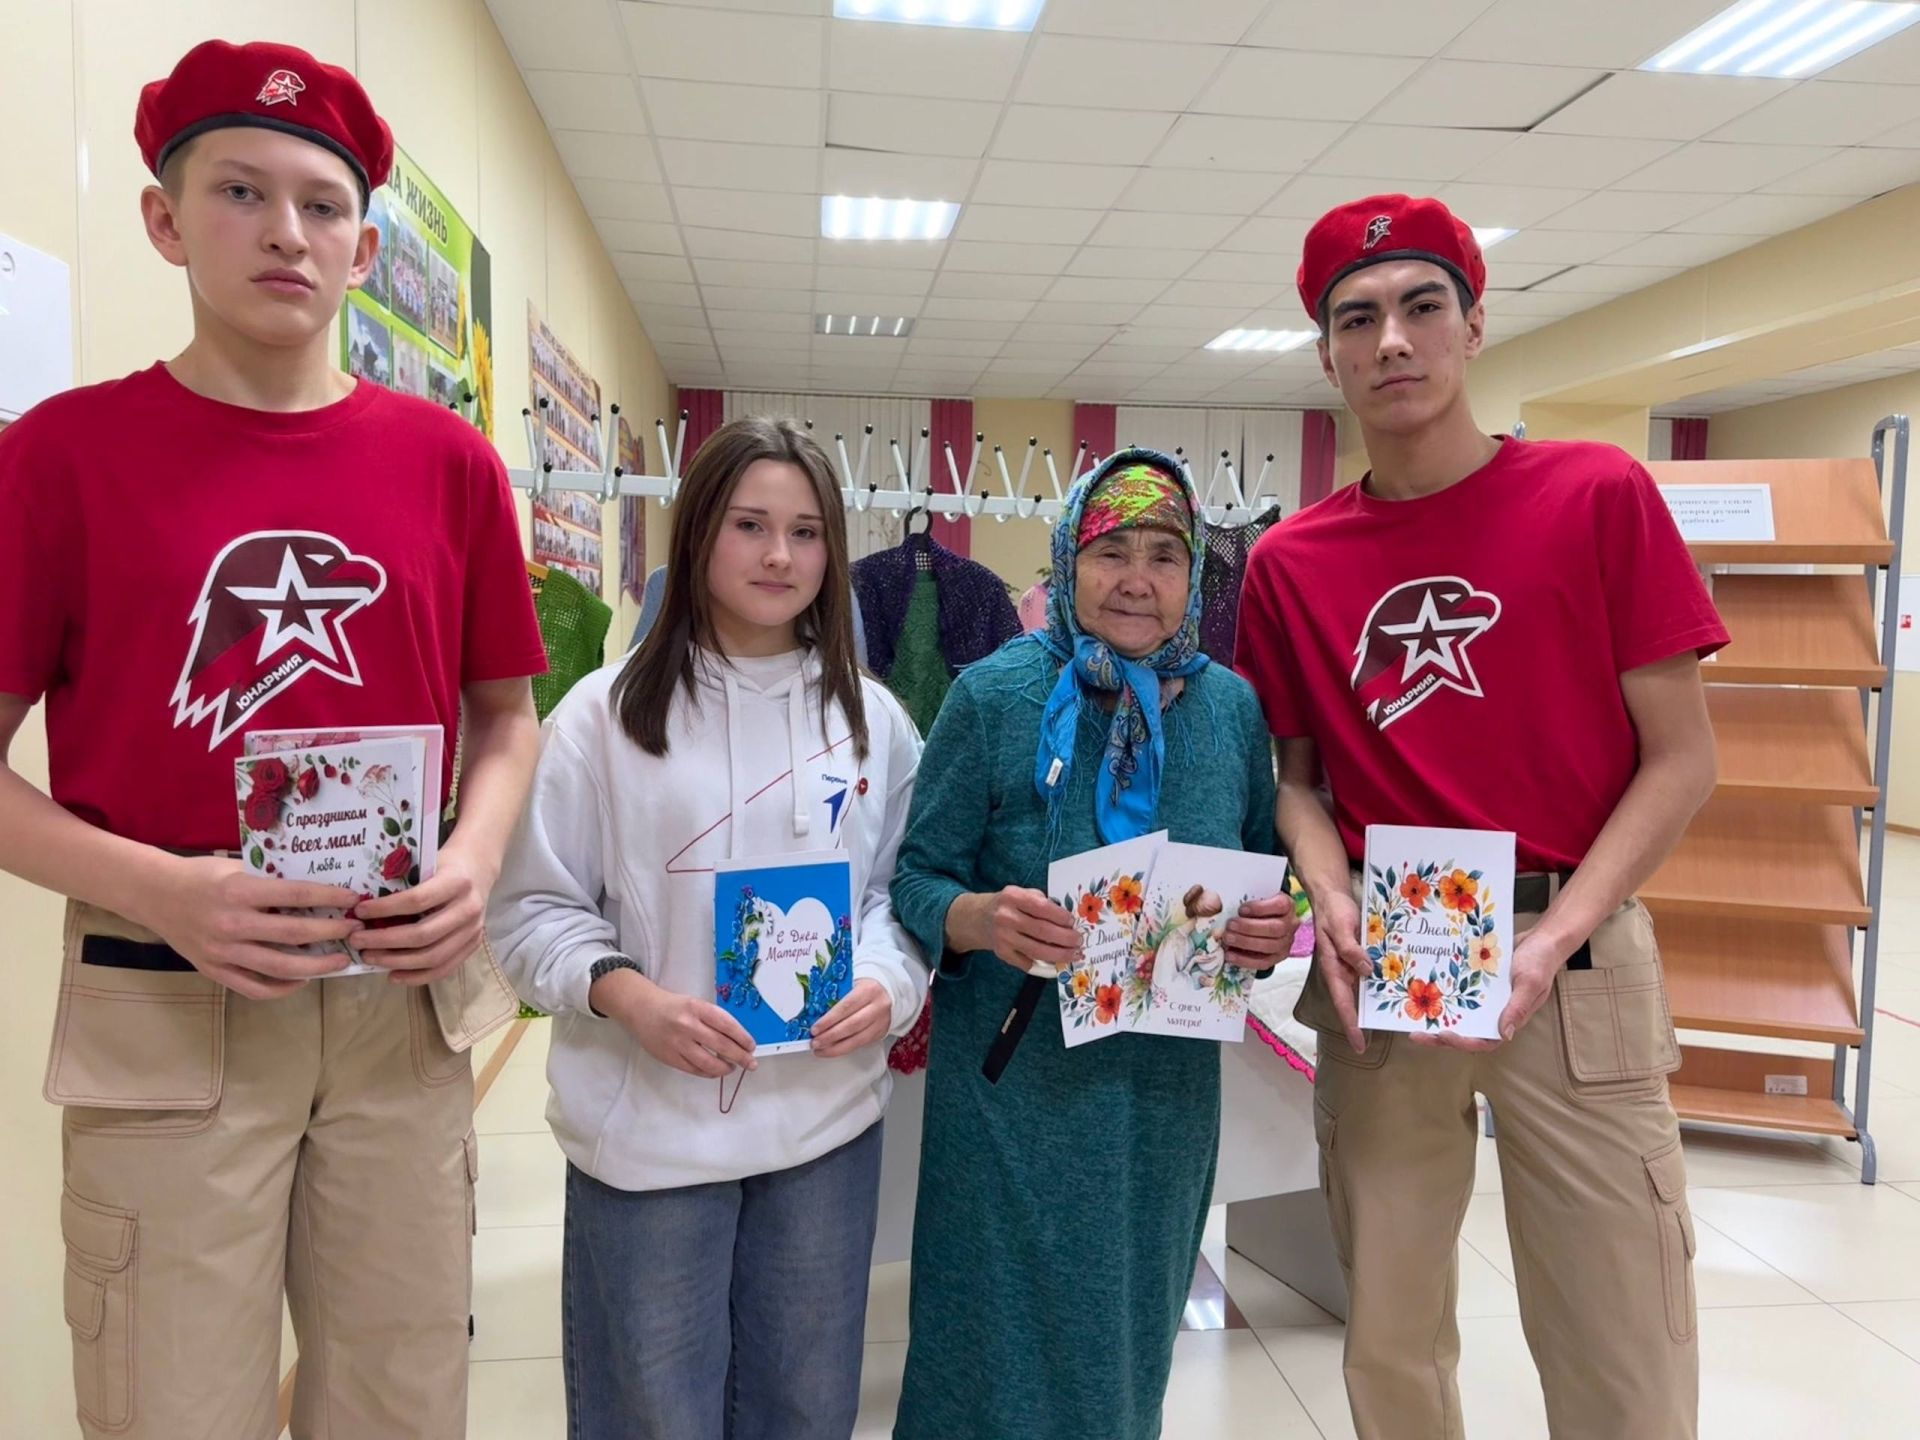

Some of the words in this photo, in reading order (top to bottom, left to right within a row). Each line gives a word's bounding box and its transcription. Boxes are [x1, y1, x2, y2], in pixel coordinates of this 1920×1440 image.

[405, 175, 449, 245] ЖИЗНЬ
[235, 653, 303, 711] ЮНАРМИЯ
[1383, 673, 1437, 716] ЮНАРМИЯ
[286, 811, 295, 828] С
[295, 808, 368, 831] праздником
[290, 834, 323, 854] всех
[323, 827, 367, 851] мам!
[307, 856, 342, 875] Любви
[347, 859, 356, 869] и
[776, 930, 785, 945] С
[1416, 916, 1453, 936] Днем
[765, 943, 813, 964] Матери!
